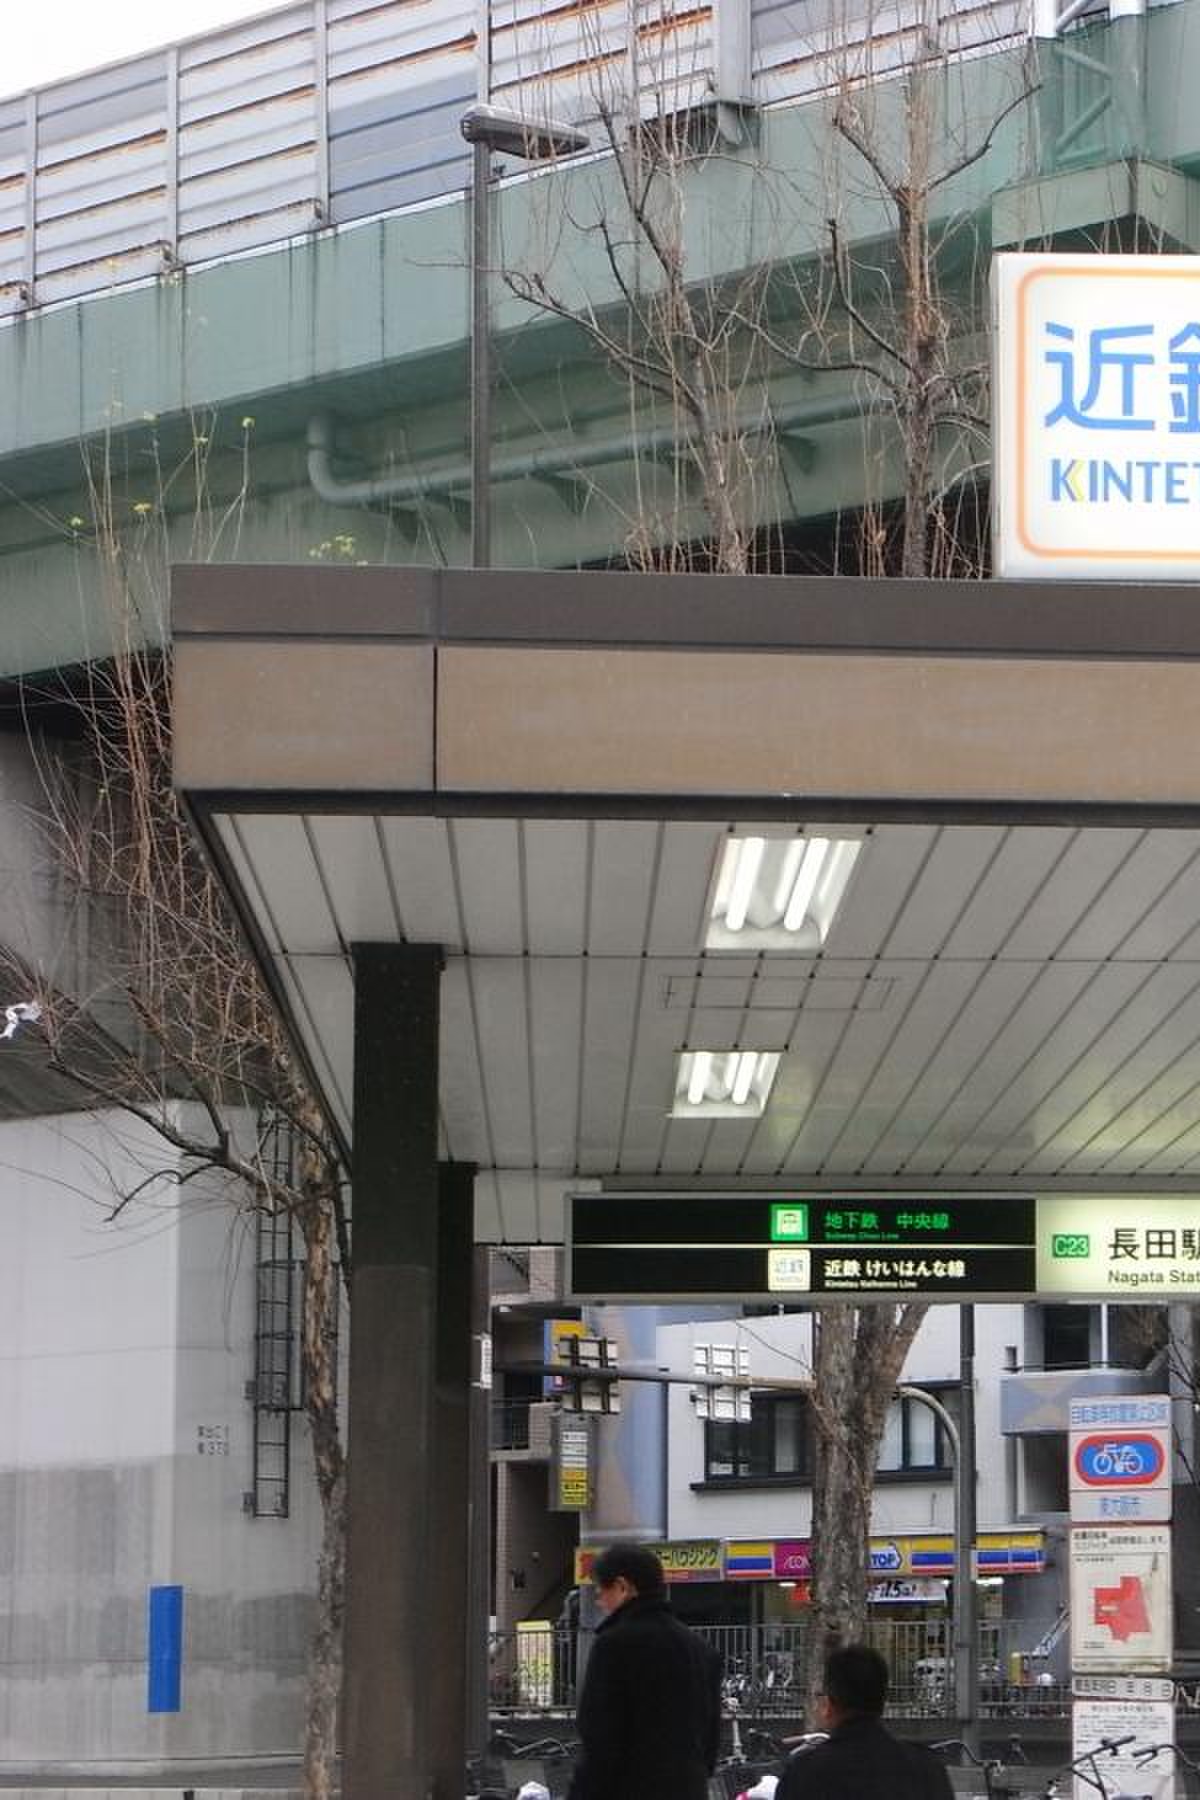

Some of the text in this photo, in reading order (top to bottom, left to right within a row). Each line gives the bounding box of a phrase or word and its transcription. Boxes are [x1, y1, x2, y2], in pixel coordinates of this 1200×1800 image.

[824, 1211, 950, 1230] 地下鉄 中央線
[1054, 1236, 1089, 1257] C23
[824, 1259, 966, 1278] 近鉄 けいはんな線
[1107, 1269, 1164, 1286] Nagata
[869, 1552, 896, 1567] TOP
